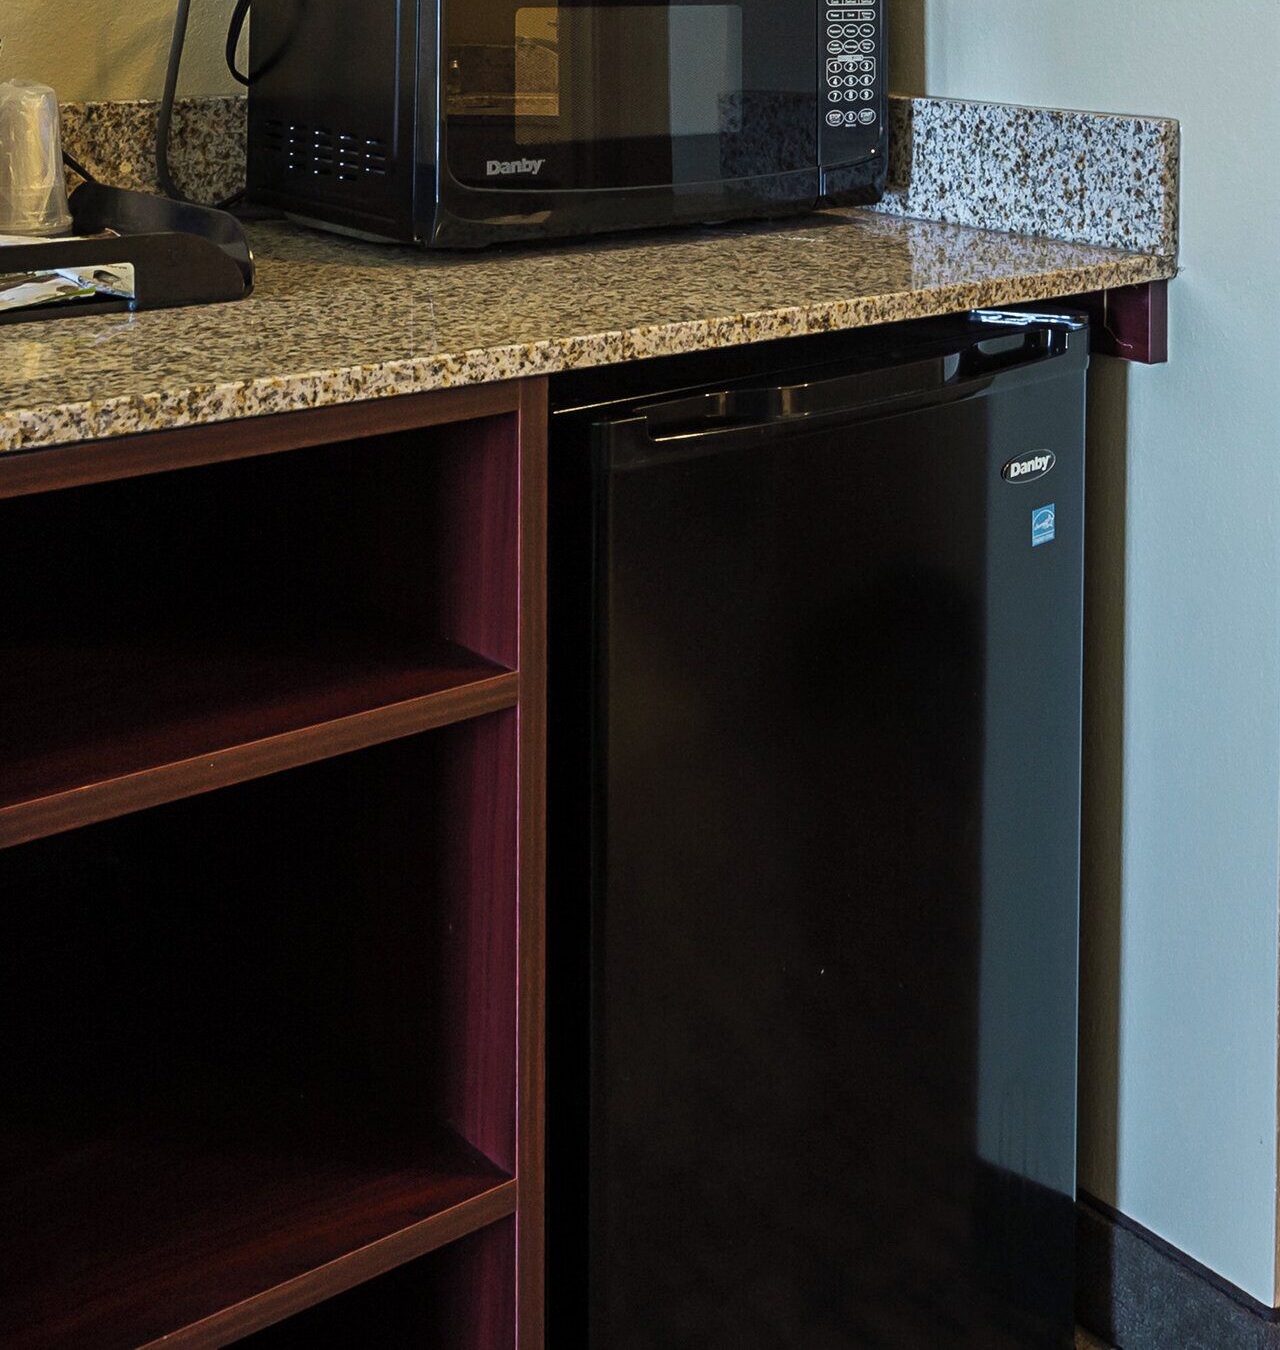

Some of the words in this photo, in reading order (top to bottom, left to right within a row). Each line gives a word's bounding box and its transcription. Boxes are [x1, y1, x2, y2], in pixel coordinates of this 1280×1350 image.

[834, 63, 837, 71] 1
[864, 62, 869, 70] 3
[849, 77, 853, 85] 5
[864, 76, 869, 84] 6
[833, 92, 838, 100] 7
[849, 91, 853, 99] 8
[864, 91, 869, 99] 9
[486, 158, 543, 176] Danby
[1010, 455, 1051, 478] Danby
